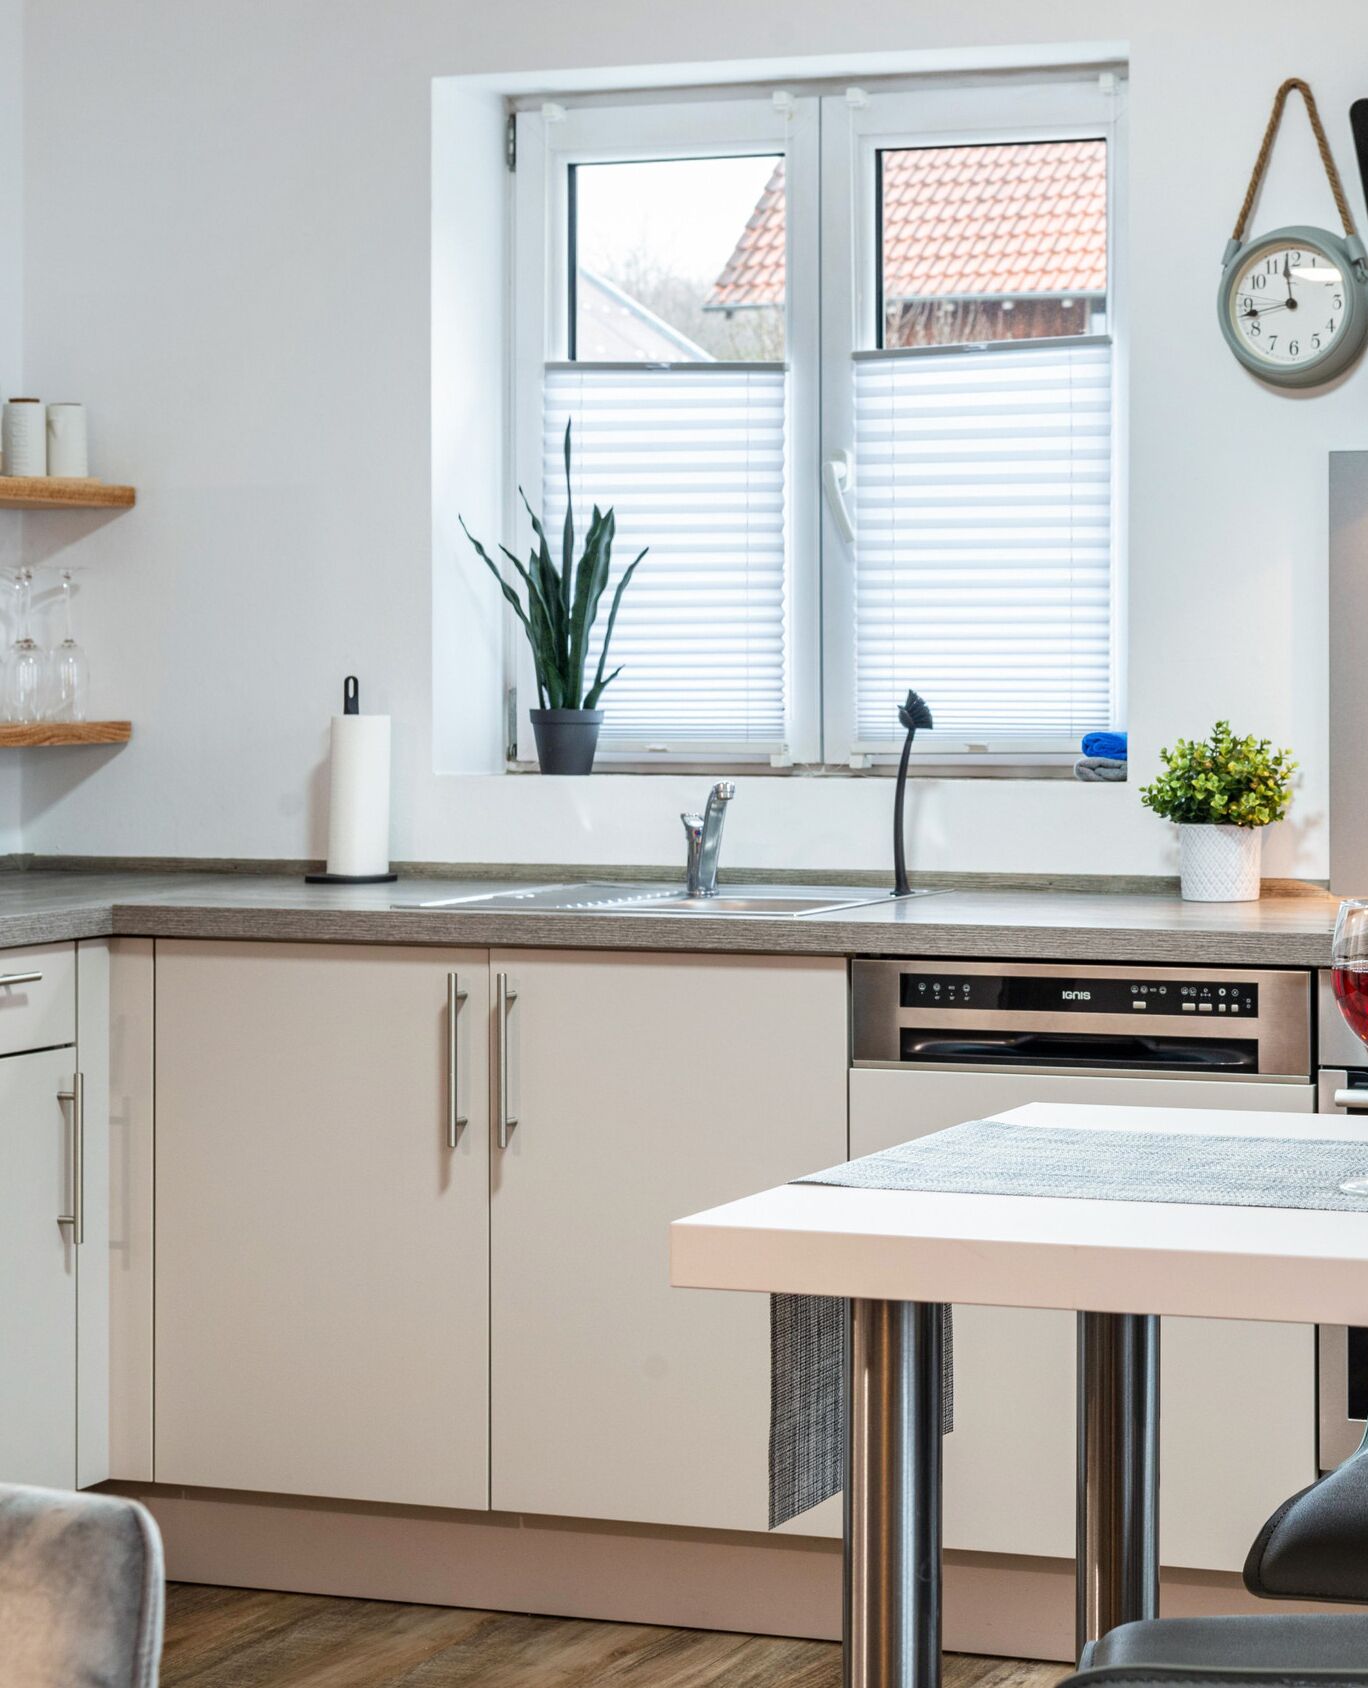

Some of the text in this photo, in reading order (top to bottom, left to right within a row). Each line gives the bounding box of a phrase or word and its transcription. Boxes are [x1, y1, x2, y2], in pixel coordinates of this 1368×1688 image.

[1266, 259, 1279, 275] 11
[1251, 274, 1266, 290] 10
[1243, 297, 1253, 313] 9
[1332, 294, 1342, 310] 3
[1250, 321, 1261, 336] 8
[1325, 318, 1336, 333] 4
[1268, 335, 1278, 351] 7
[1289, 340, 1299, 356] 6
[1311, 333, 1321, 349] 5
